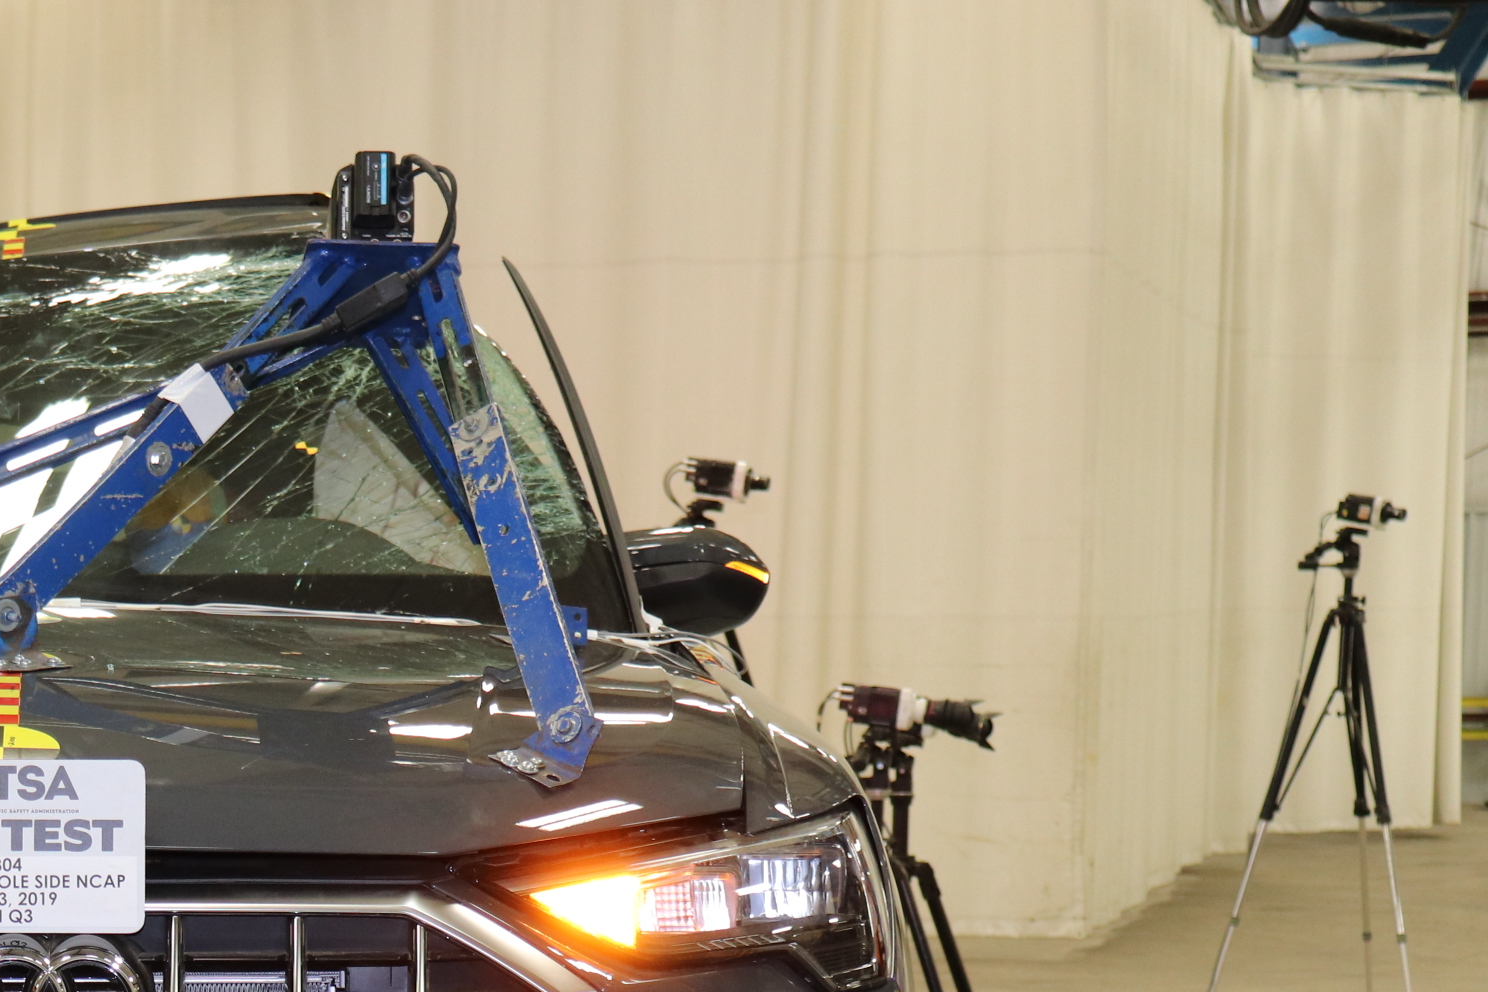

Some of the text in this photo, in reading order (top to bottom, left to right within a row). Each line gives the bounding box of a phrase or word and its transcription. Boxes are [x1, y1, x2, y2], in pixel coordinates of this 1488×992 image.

[0, 818, 124, 852] TEST
[35, 874, 70, 889] SIDE
[76, 874, 126, 889] NCAP
[18, 891, 58, 906] 2019
[8, 908, 33, 924] Q3
